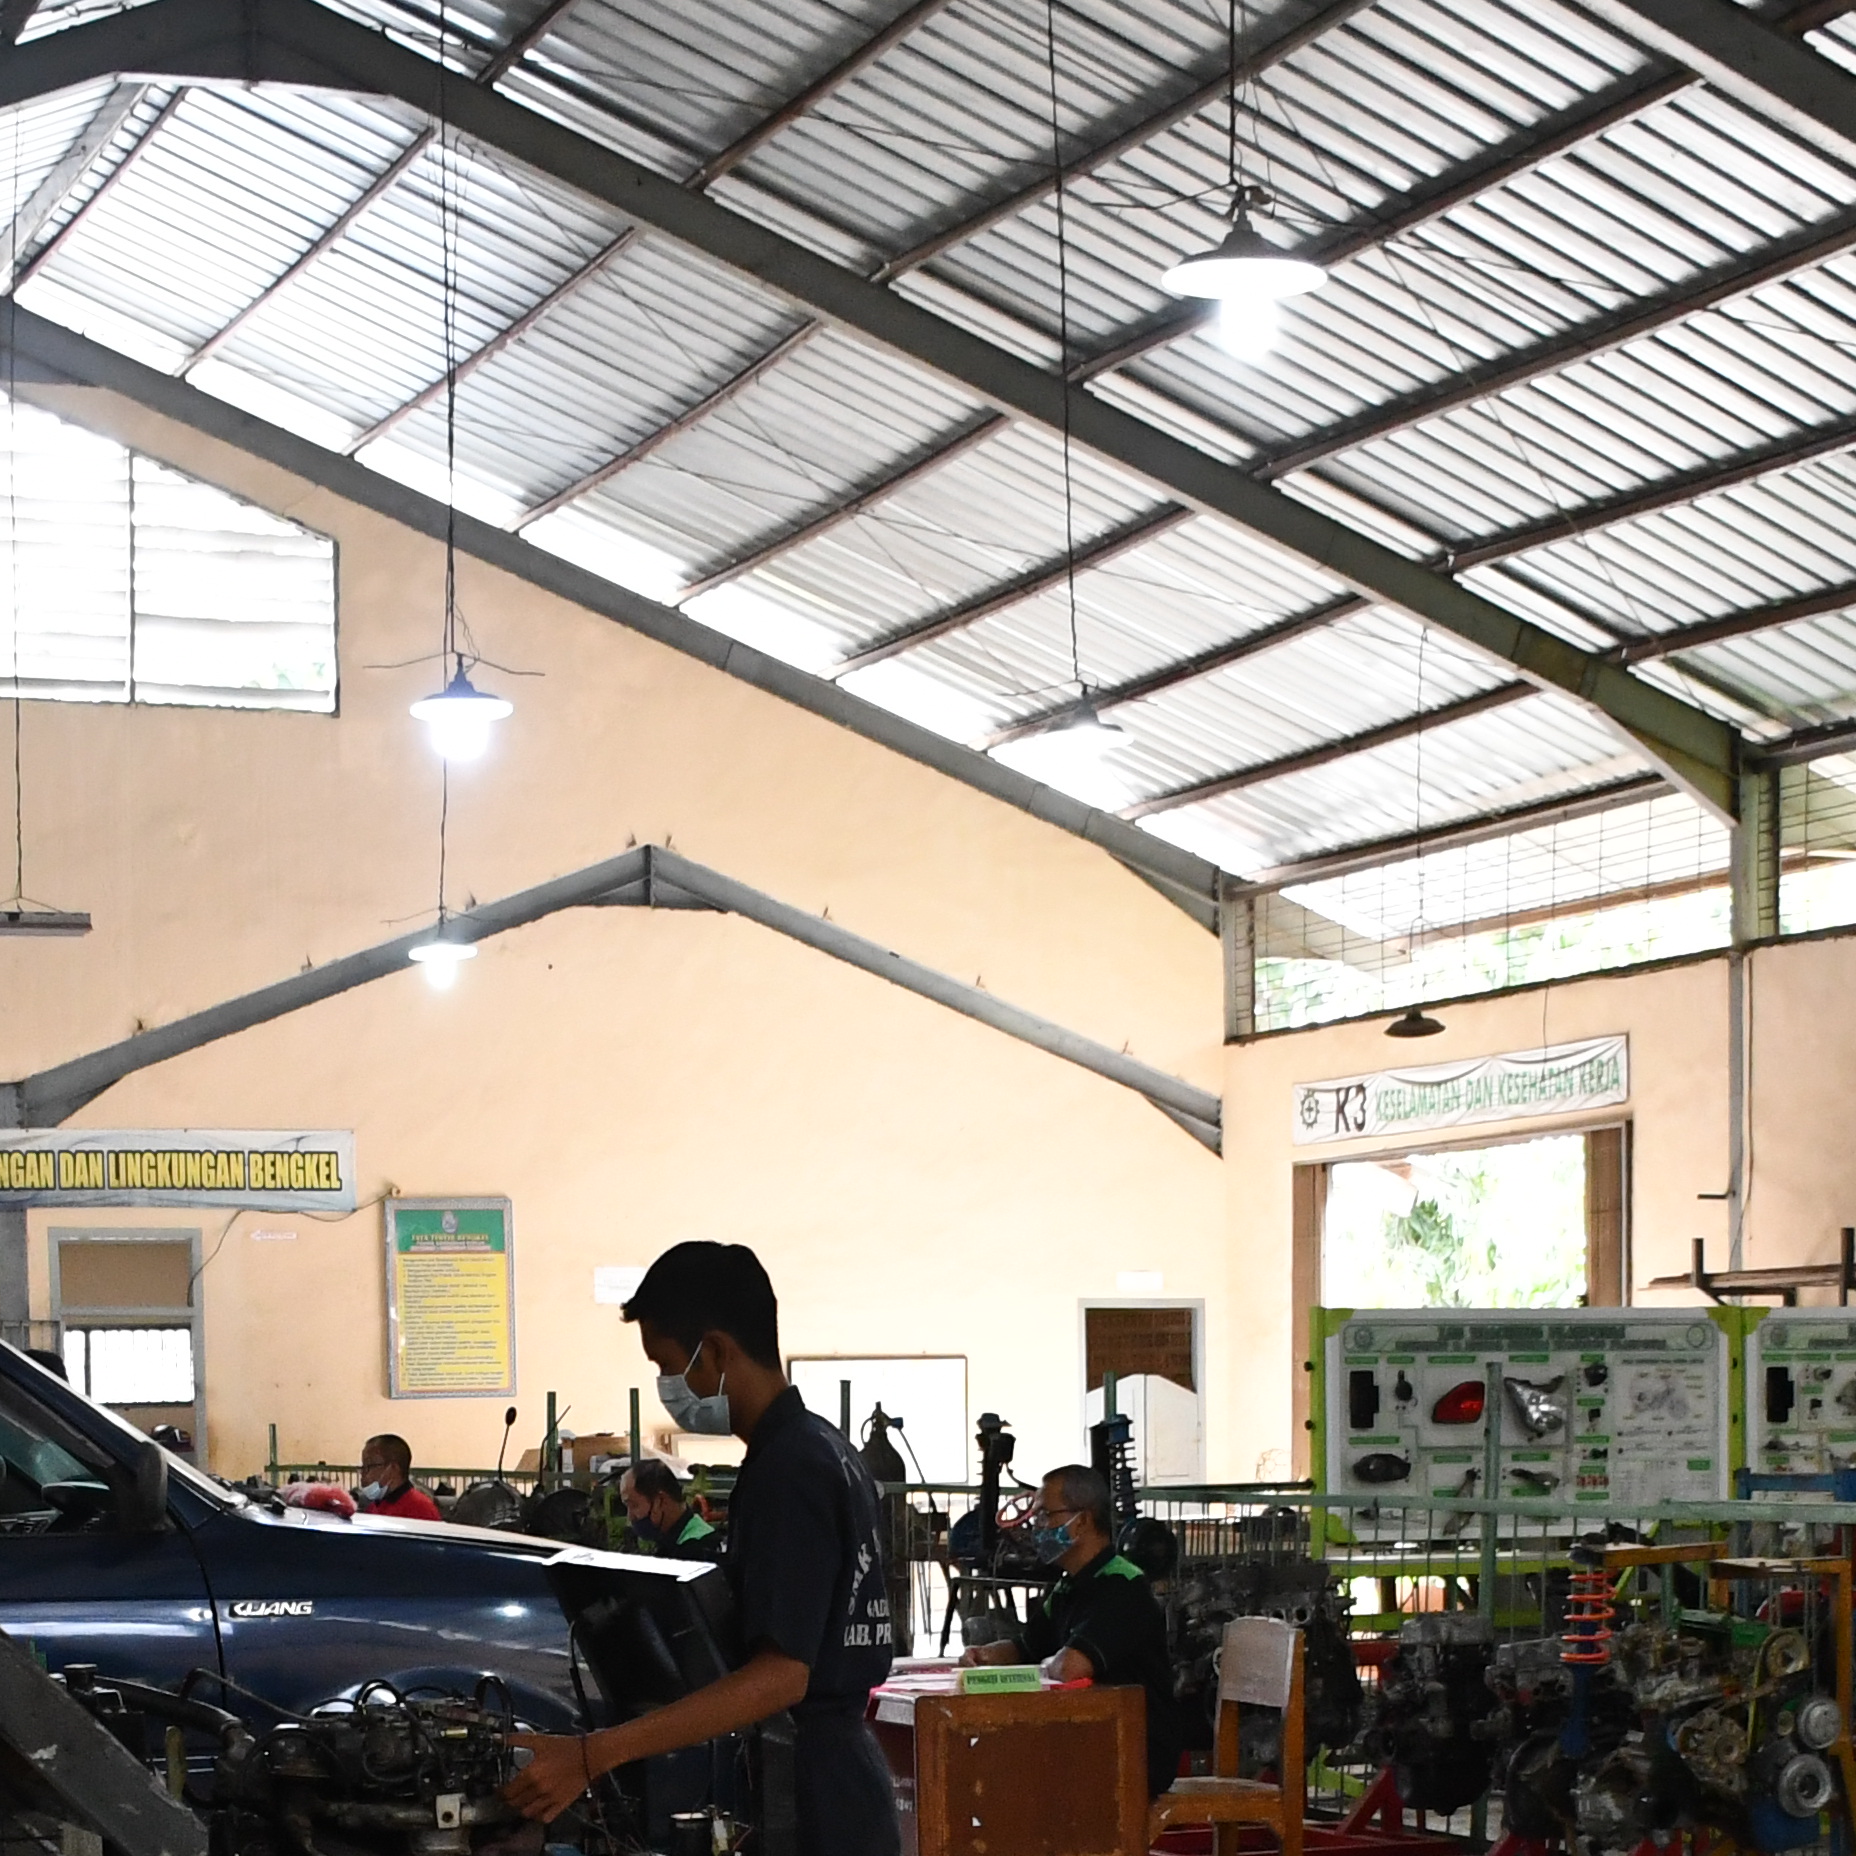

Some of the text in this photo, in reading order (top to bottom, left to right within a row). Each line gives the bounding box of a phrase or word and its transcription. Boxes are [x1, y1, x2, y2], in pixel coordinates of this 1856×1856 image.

[1334, 1056, 1622, 1134] K3 KESELAMATAN DAN KESEHATAN KERJA
[60, 1150, 105, 1189] DAN
[110, 1150, 246, 1190] LINGKUNGAN
[250, 1151, 342, 1191] BENGKEL
